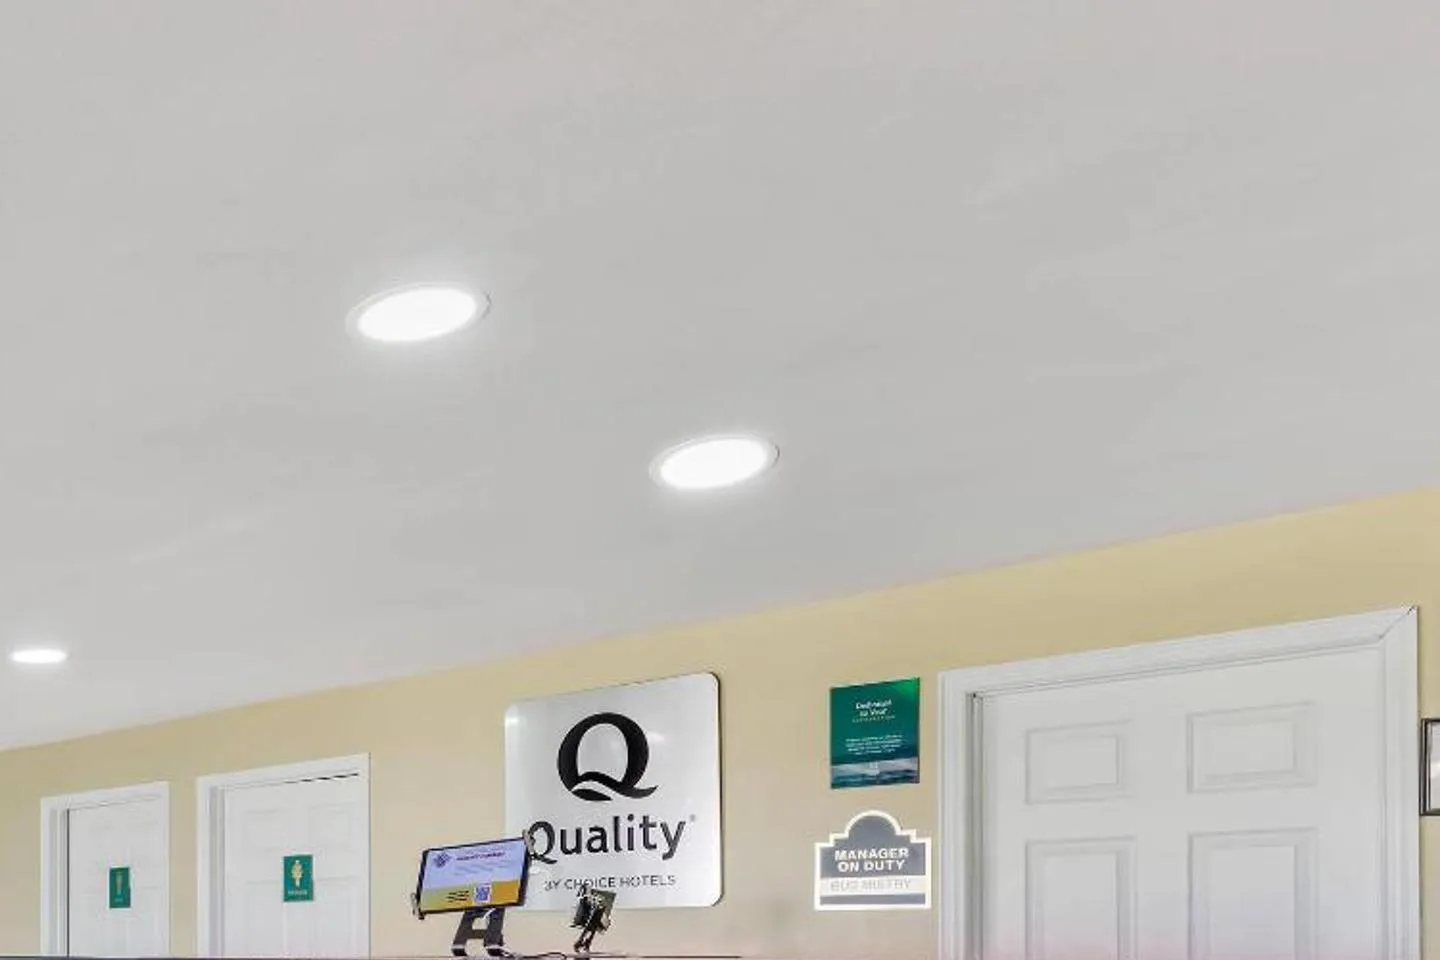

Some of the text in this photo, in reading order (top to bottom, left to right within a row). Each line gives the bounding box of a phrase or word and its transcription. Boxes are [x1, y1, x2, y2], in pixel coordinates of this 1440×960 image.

[557, 712, 659, 801] Q
[528, 813, 687, 865] Quality
[834, 847, 909, 861] MANAGER
[837, 859, 905, 873] ON DUTY
[564, 876, 616, 891] CHOICE
[619, 874, 677, 888] HOTELS
